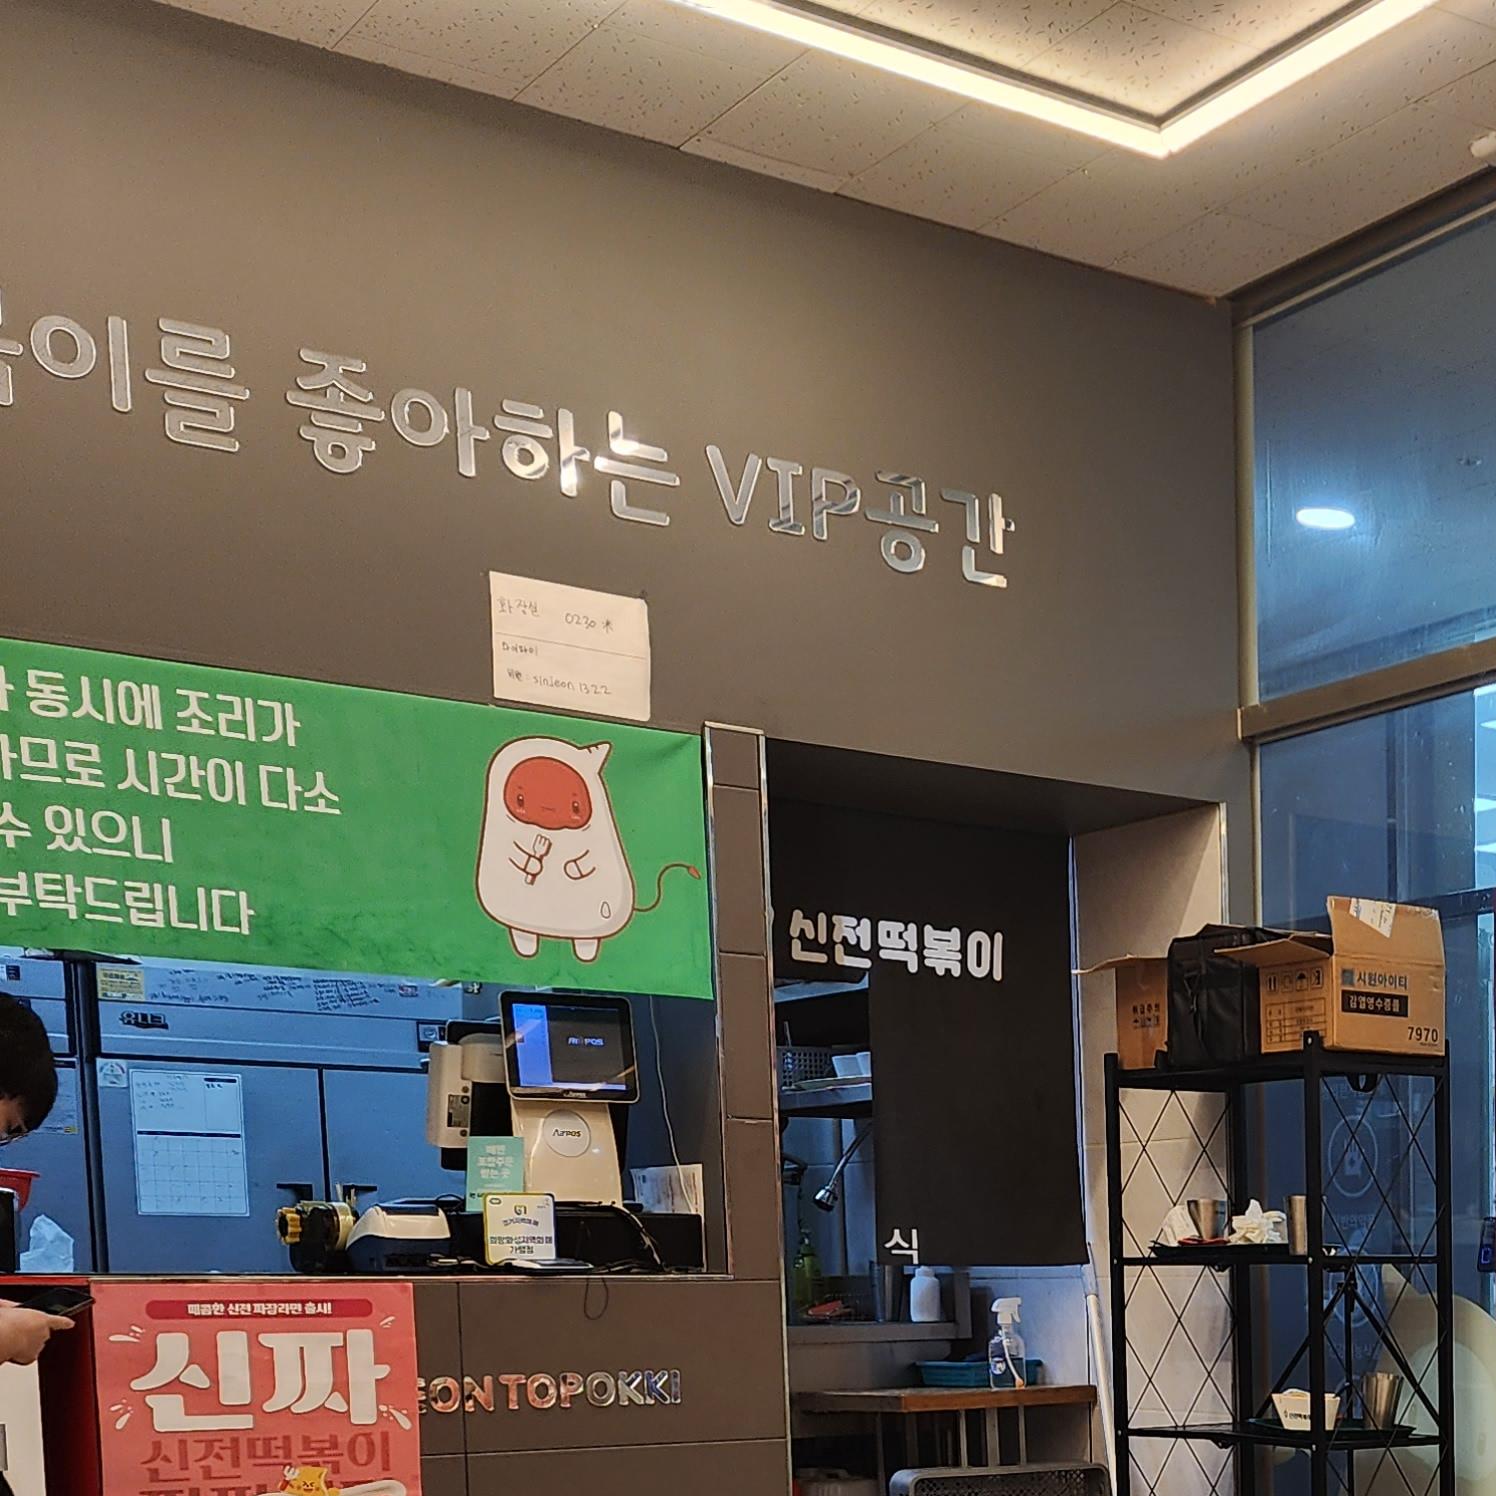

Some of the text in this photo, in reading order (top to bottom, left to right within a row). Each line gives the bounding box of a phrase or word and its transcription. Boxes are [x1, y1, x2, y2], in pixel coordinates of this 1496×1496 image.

[286, 347, 680, 527] 좋아하는
[705, 443, 1016, 588] VIP공간
[26, 669, 163, 730] 동시에
[175, 688, 301, 747] 조리가
[117, 748, 247, 805] 시간이
[258, 764, 342, 815] 다소
[44, 805, 174, 863] 있으니
[0, 871, 256, 935] 부탁드립니다
[789, 908, 1002, 981] 신전떡볶이
[1407, 1026, 1439, 1043] 7970
[885, 1227, 919, 1264] 식
[227, 1302, 252, 1315] 신전
[130, 1328, 390, 1432] 신짜
[499, 1370, 681, 1410] TOPOKKI
[141, 1430, 391, 1484] 신전떡볶이
